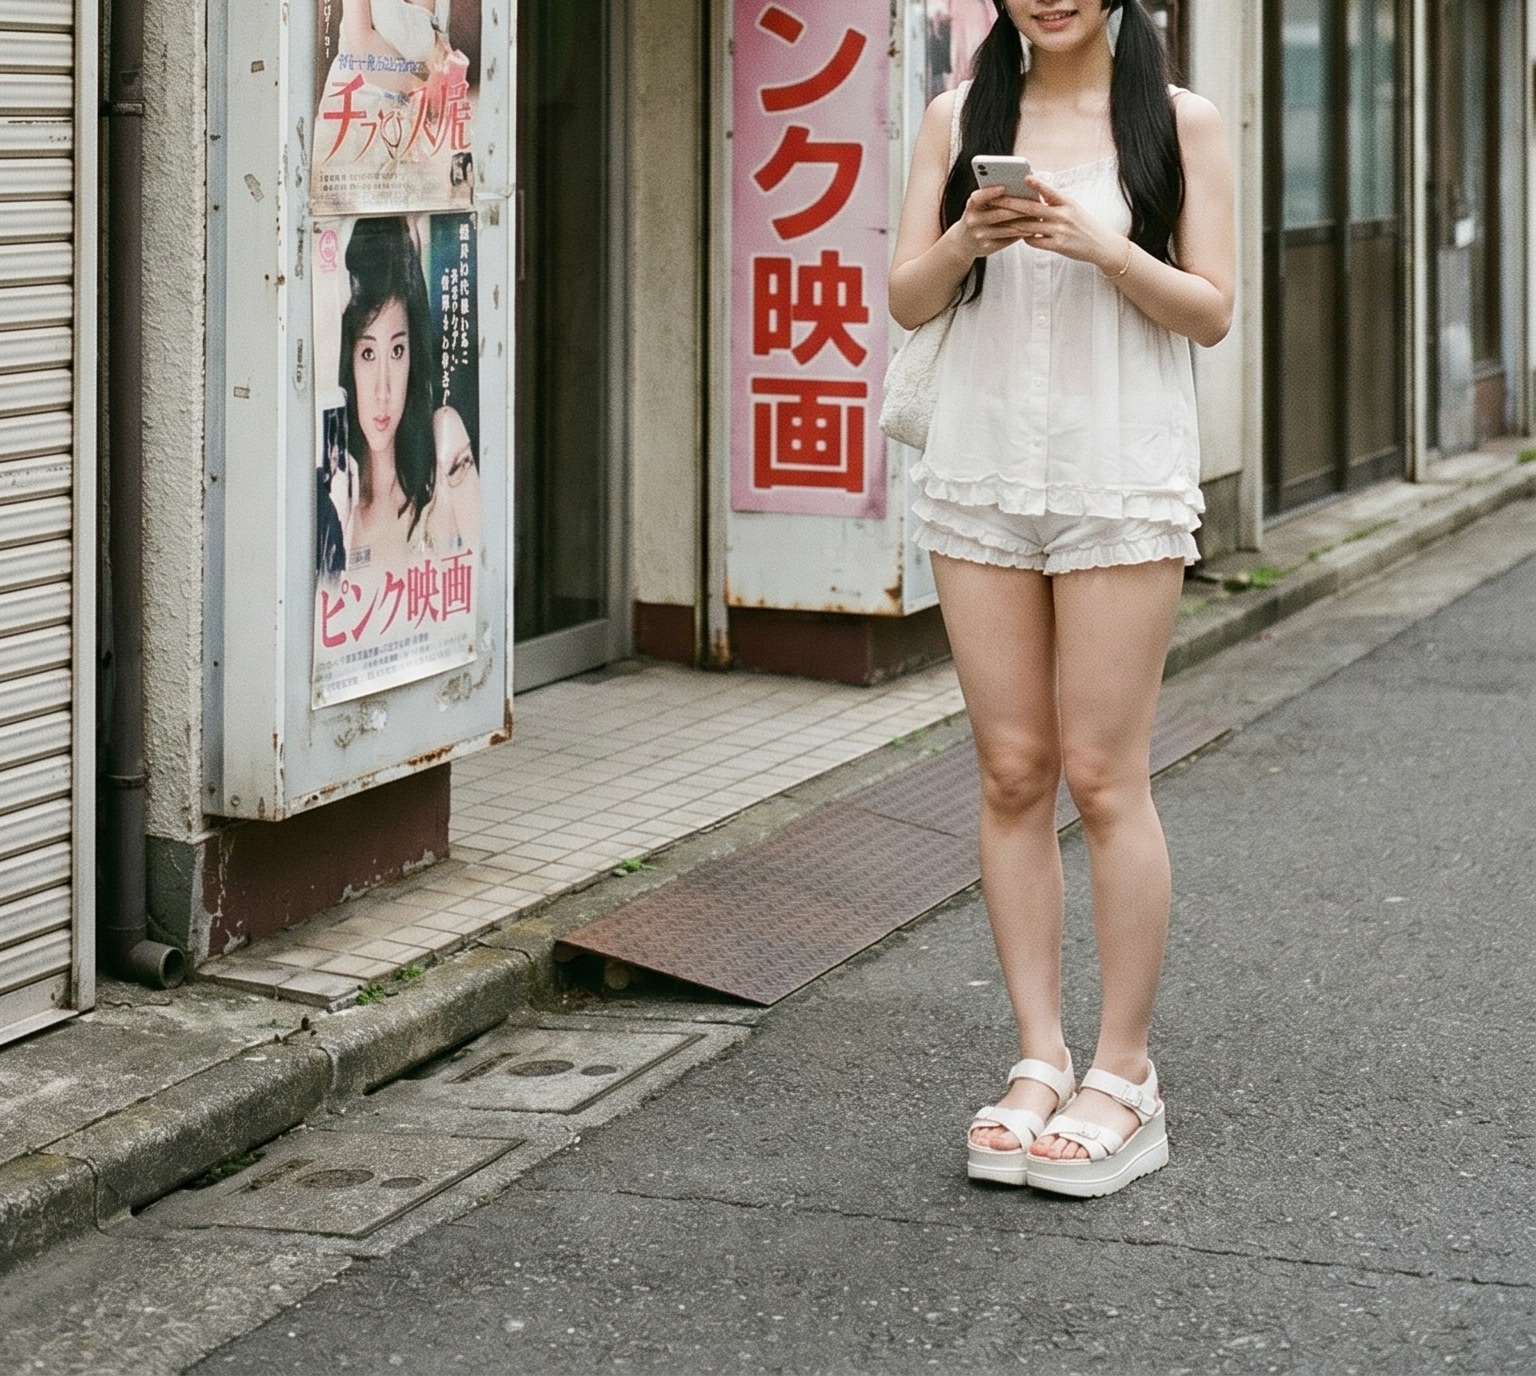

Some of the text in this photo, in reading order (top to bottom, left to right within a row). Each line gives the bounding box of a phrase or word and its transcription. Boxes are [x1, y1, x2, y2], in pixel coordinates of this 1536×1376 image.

[321, 548, 474, 649] ピンク映画
